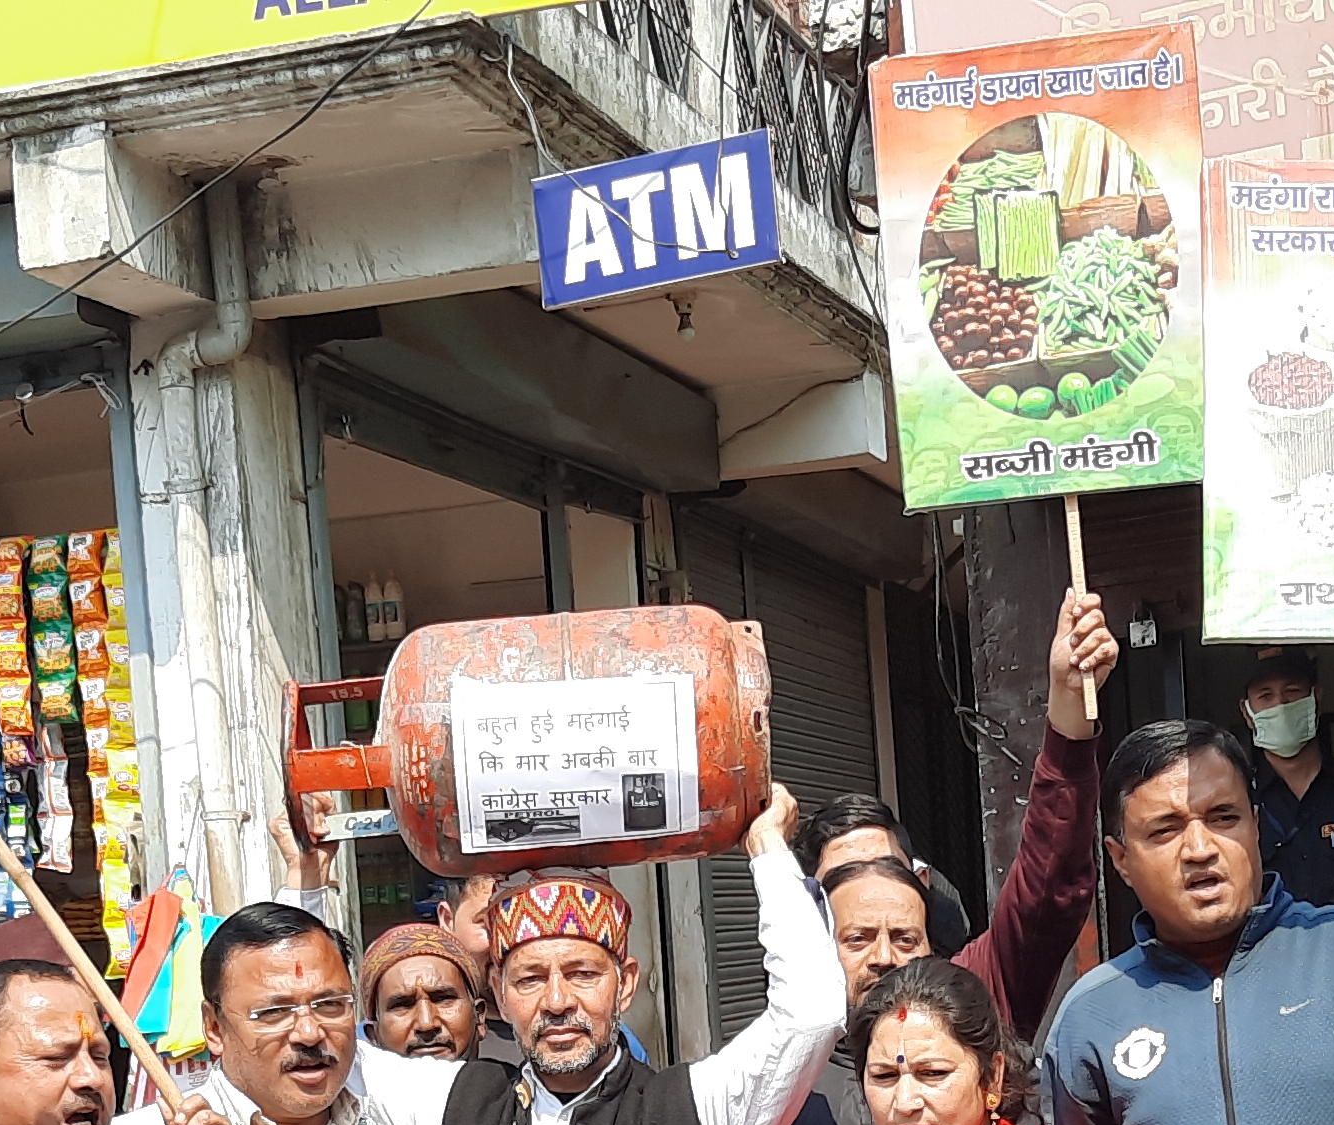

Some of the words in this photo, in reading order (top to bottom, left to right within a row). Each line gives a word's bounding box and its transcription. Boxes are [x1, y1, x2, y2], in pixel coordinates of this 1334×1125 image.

[894, 70, 976, 108] महंगाई
[981, 73, 1041, 102] डायन
[1046, 67, 1094, 94] खाए
[1098, 62, 1148, 87] जात
[1230, 177, 1310, 212] महंगा
[563, 153, 757, 285] ATM
[963, 440, 1054, 479] सब्जी
[476, 715, 518, 746] बहुत
[531, 708, 555, 744] हुई
[478, 750, 505, 774] कि
[515, 753, 551, 772] मार
[561, 745, 617, 770] अबकी
[627, 749, 659, 767] बार
[481, 786, 540, 811] कांग्रेस
[548, 788, 613, 806] सरकार
[504, 808, 565, 820] PETROL
